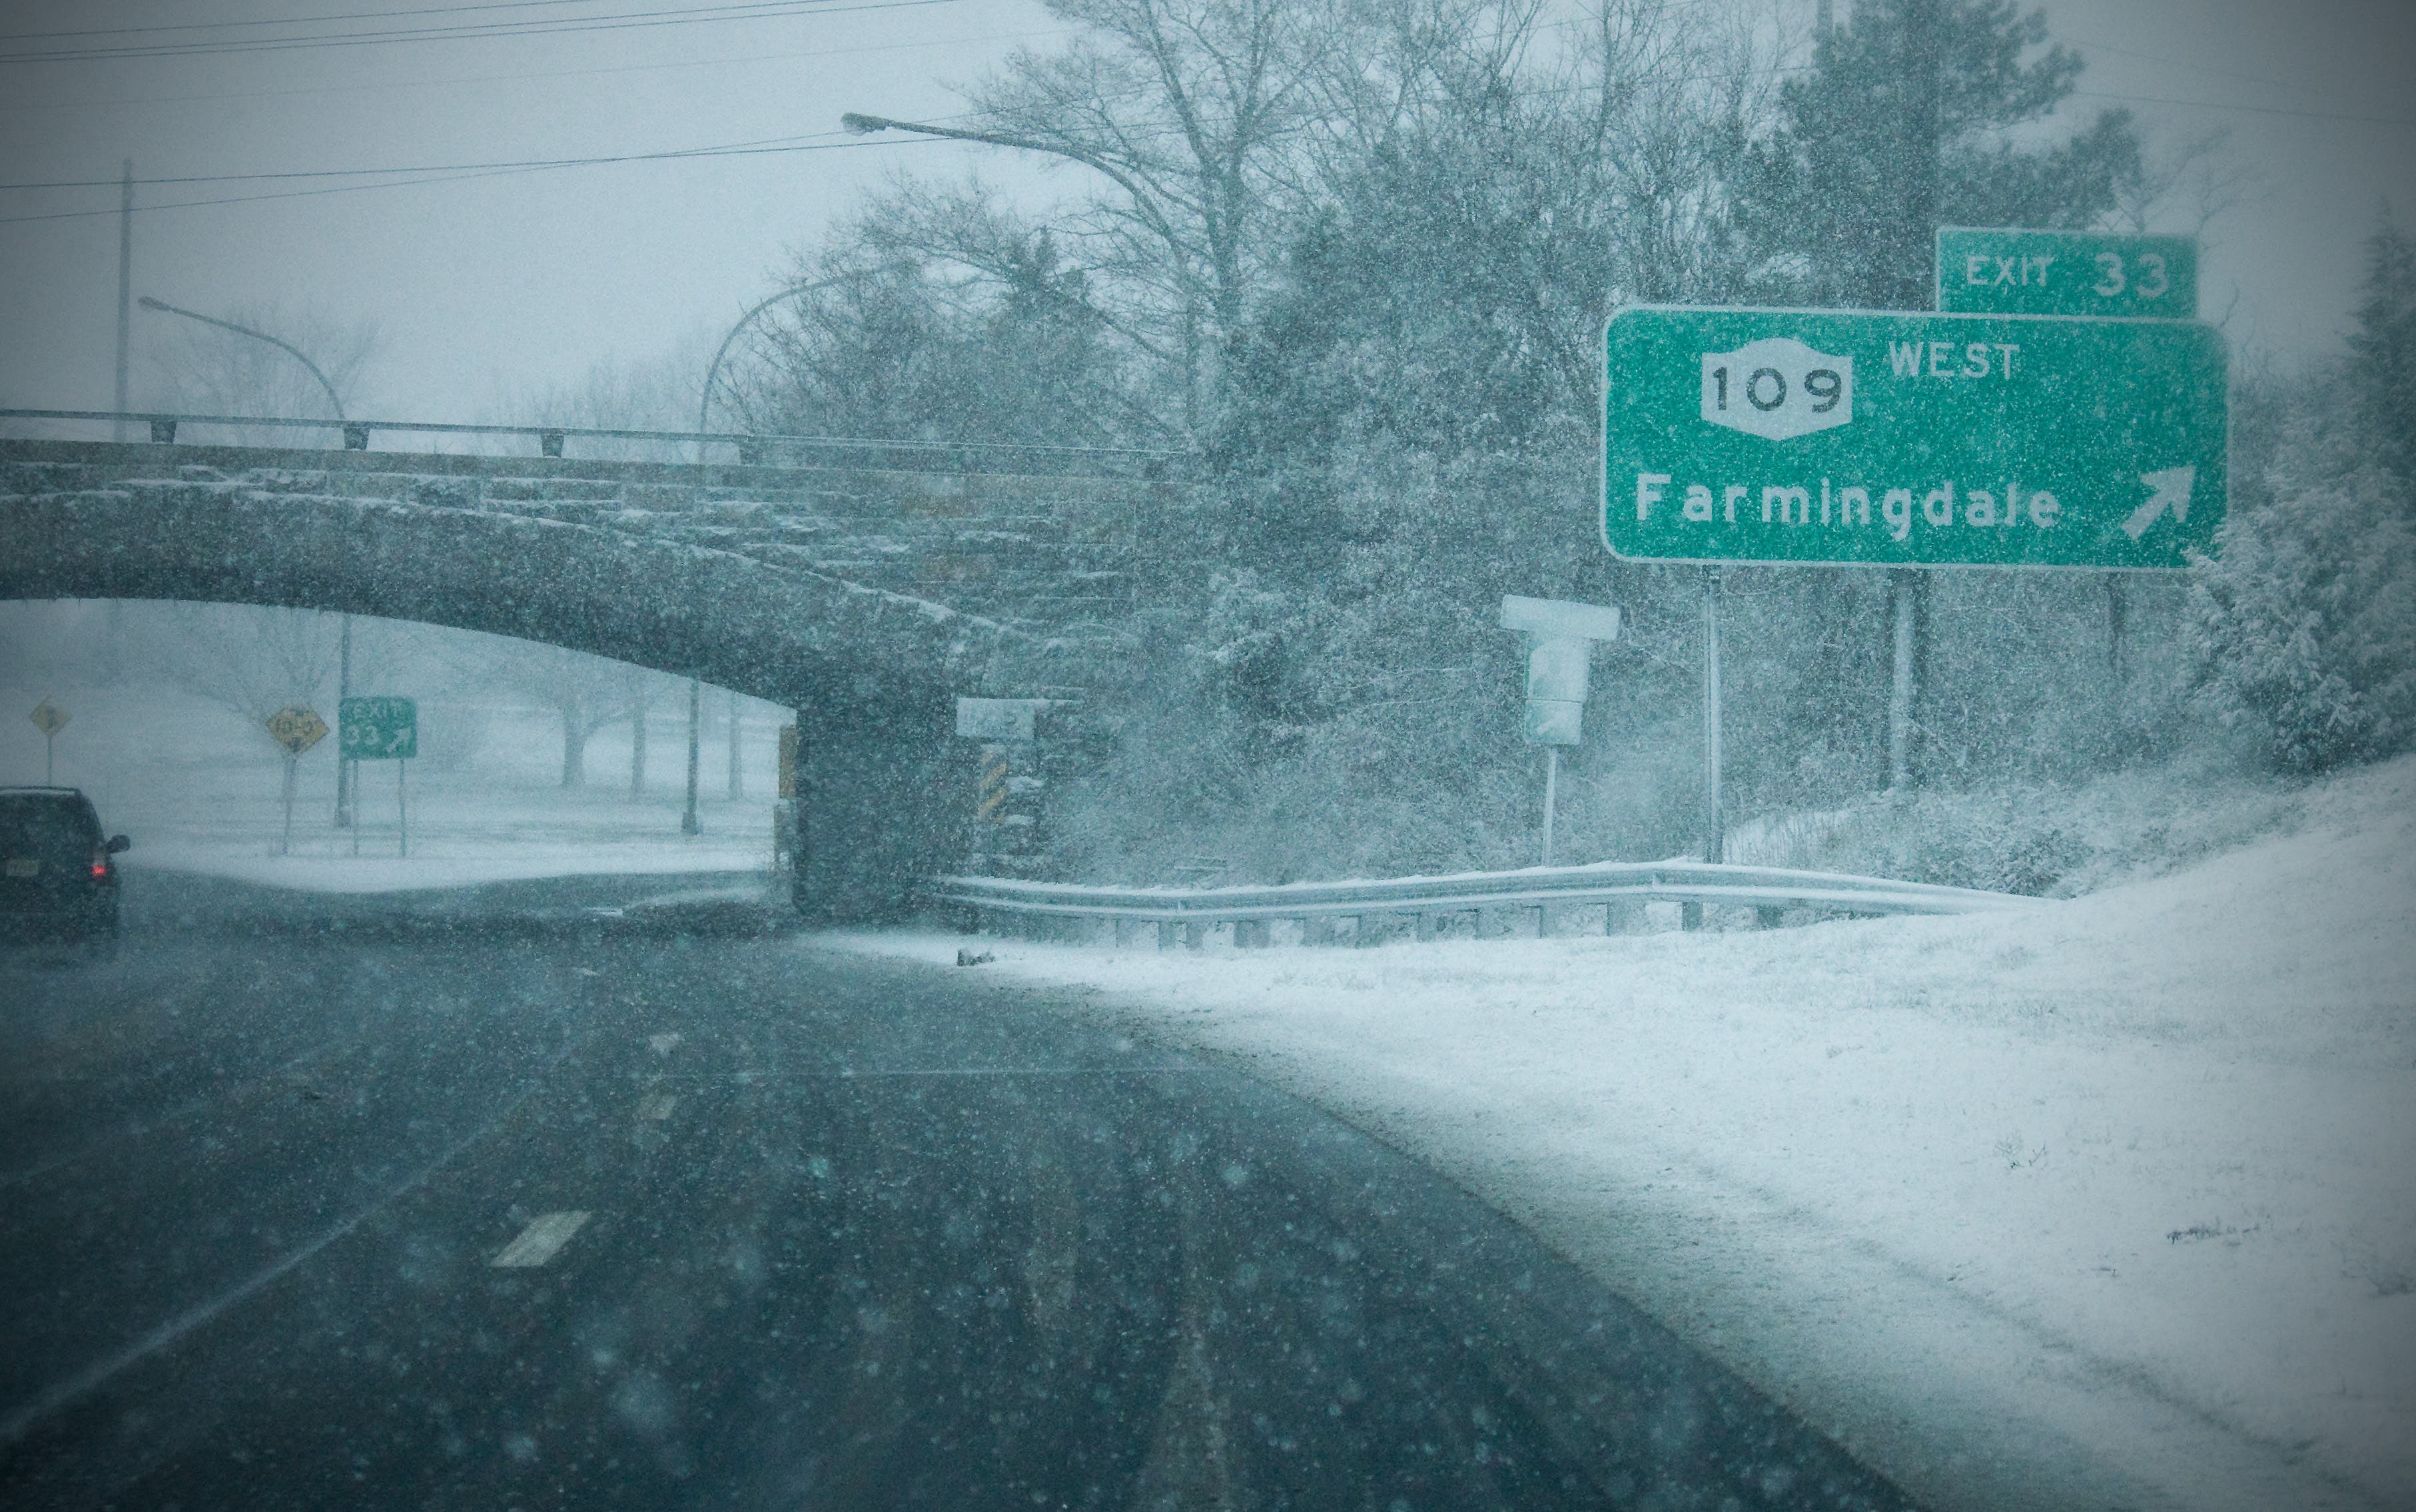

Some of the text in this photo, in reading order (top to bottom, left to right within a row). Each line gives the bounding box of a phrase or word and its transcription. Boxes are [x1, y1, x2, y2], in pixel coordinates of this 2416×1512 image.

[1967, 252, 2168, 297] EXIT 33
[1889, 341, 2020, 380] WEST
[1713, 366, 1842, 413] 109
[1637, 474, 2060, 540] Farmingdale
[354, 701, 402, 719] EXIT
[346, 725, 380, 745] 33
